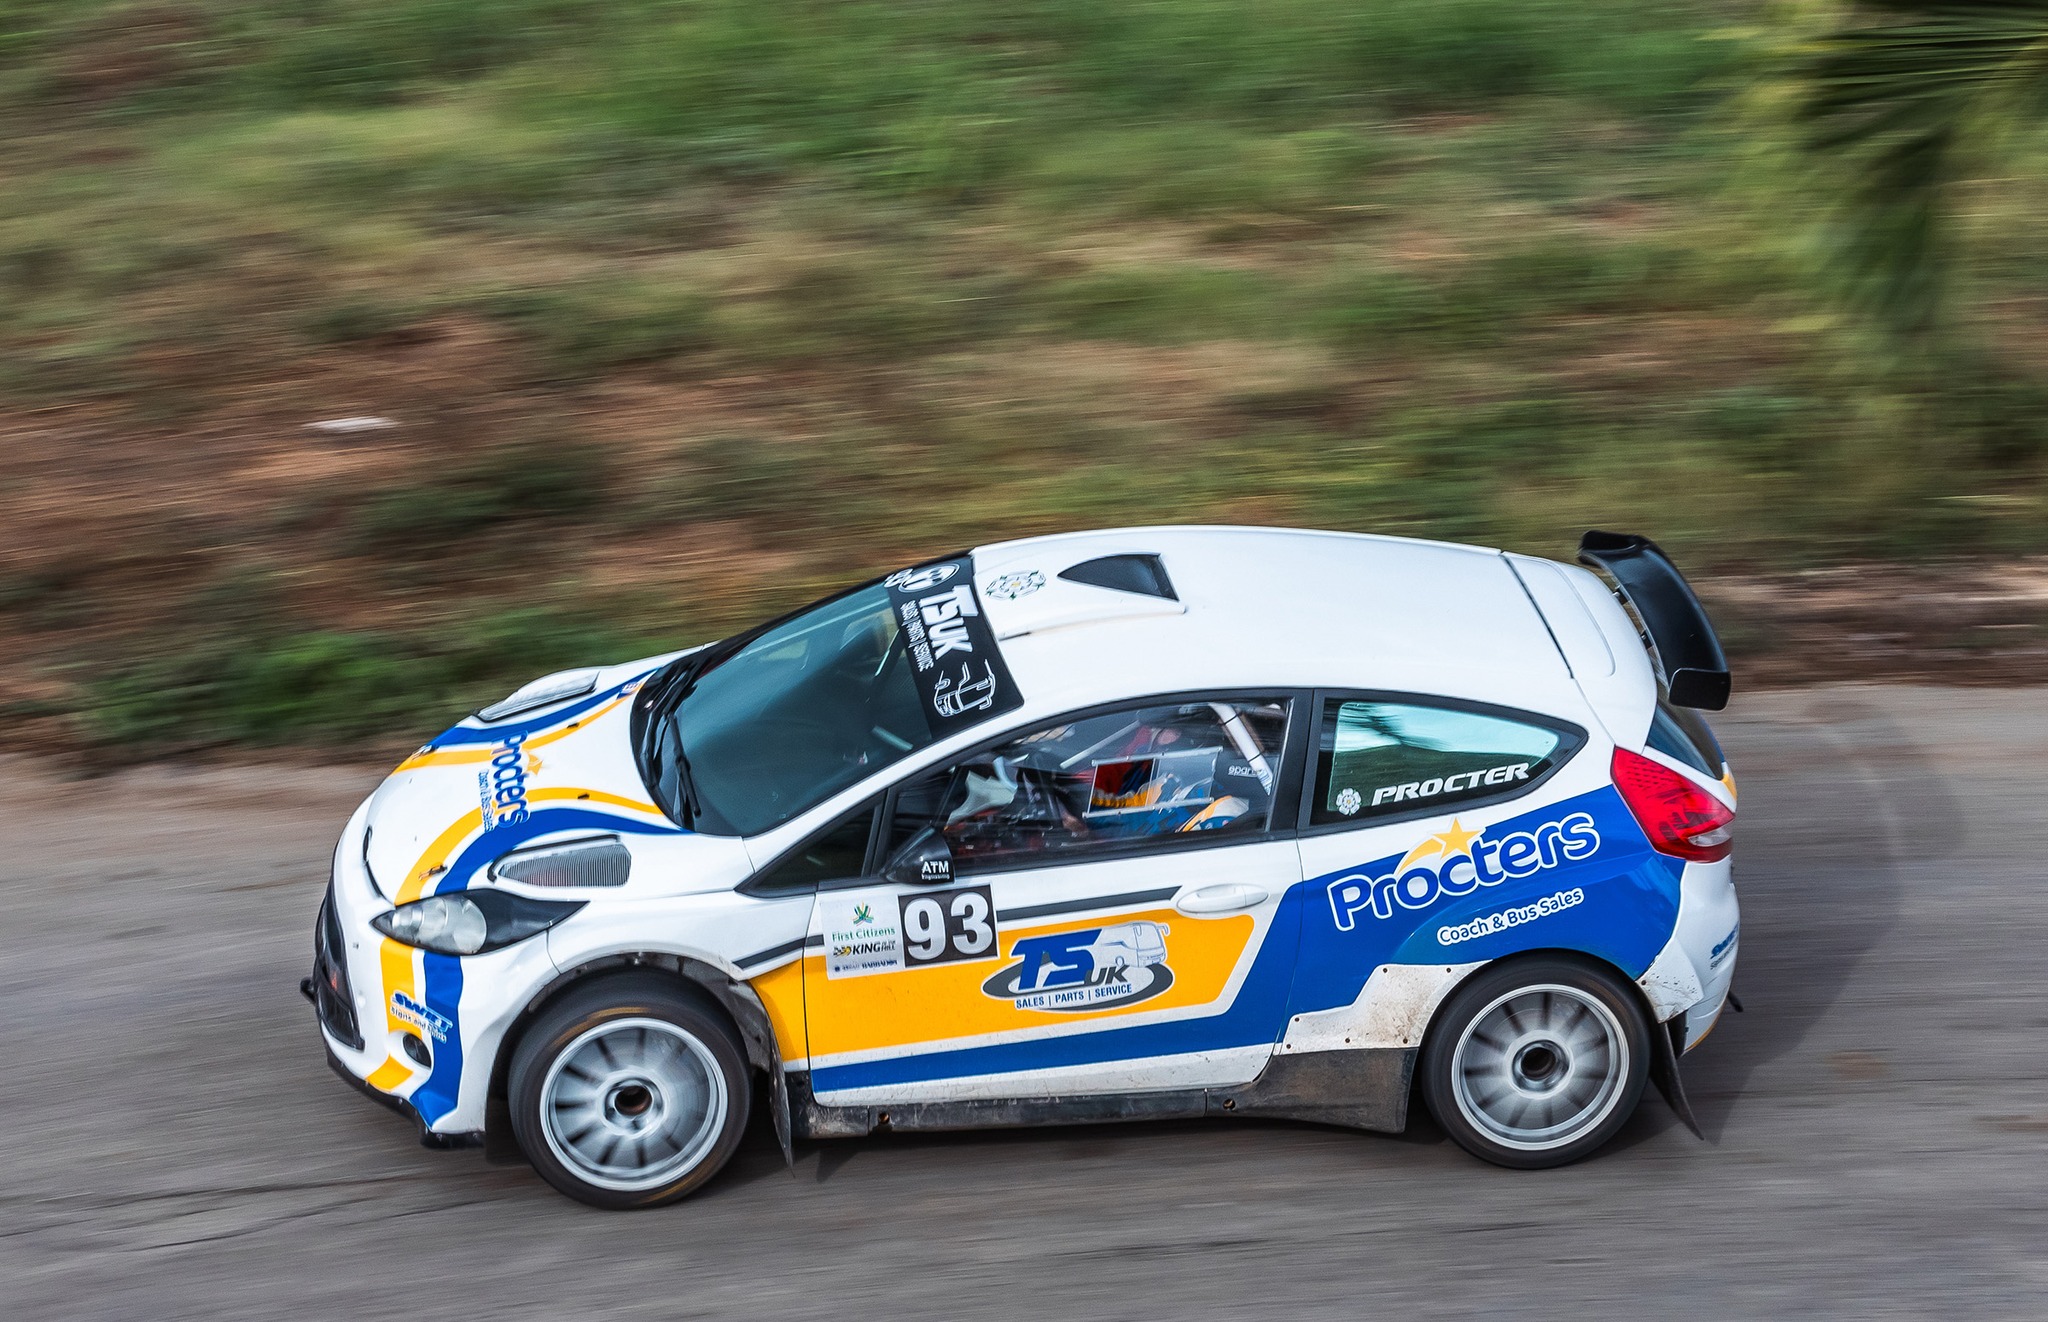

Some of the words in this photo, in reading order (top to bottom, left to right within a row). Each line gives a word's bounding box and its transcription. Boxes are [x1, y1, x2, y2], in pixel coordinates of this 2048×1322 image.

[918, 584, 979, 660] TSUK
[491, 730, 530, 826] Procters
[1371, 763, 1530, 807] PROCTER
[922, 860, 950, 874] ATM
[1327, 812, 1601, 931] Procters
[832, 930, 854, 942] First
[856, 927, 896, 939] Citizens
[904, 891, 993, 961] 93
[1439, 921, 1488, 943] Coach
[1492, 916, 1505, 929] &
[1508, 904, 1538, 924] Bus
[1539, 889, 1582, 913] Sales
[853, 941, 880, 955] KING
[1016, 996, 1045, 1010] SALES
[1055, 990, 1085, 1003] PARTS
[1095, 983, 1133, 998] SERVICE
